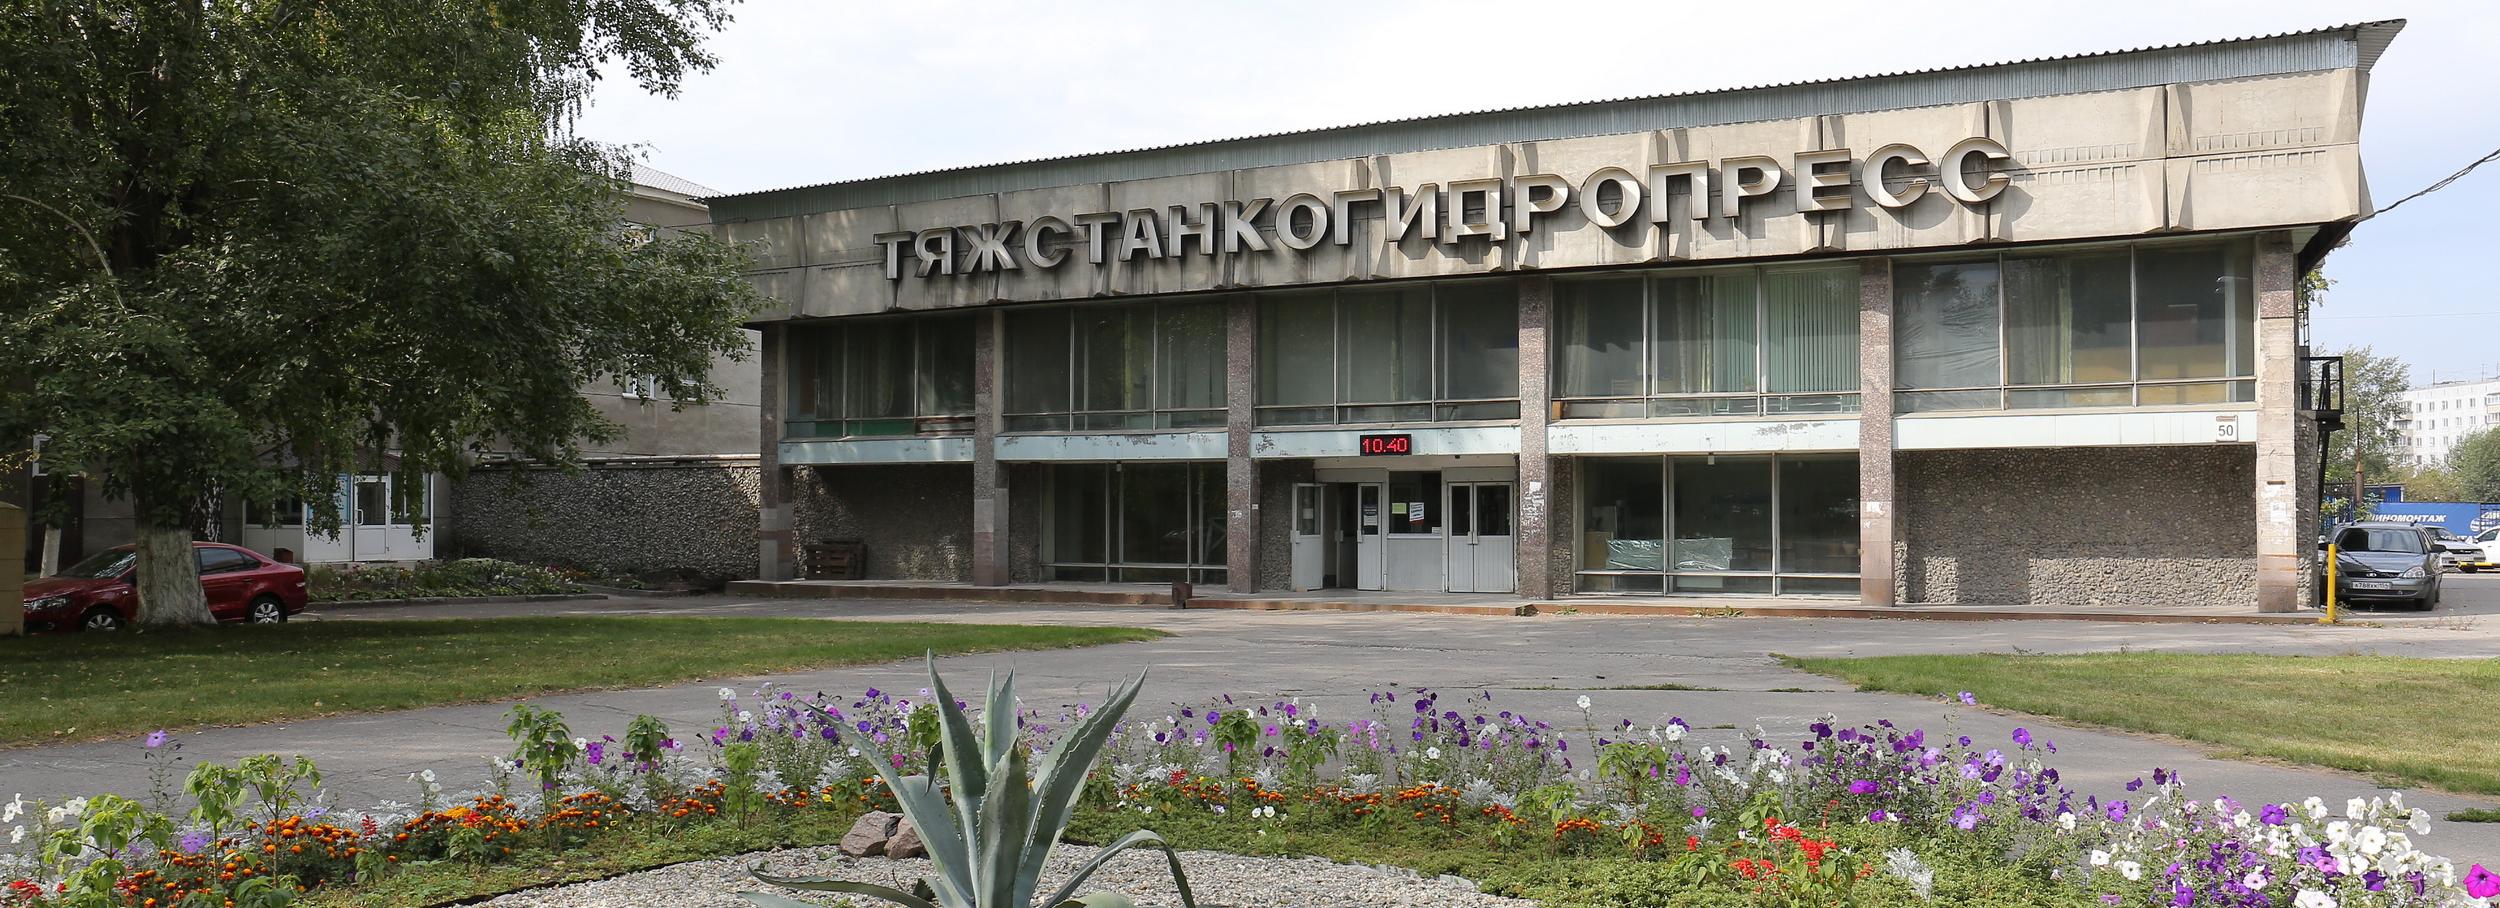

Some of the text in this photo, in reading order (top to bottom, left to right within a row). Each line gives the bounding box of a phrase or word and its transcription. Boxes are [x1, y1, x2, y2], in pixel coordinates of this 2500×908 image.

[873, 136, 2012, 280] ТЯЖСТАНКОГИДРОПРЕСС
[2218, 424, 2234, 437] 50
[1362, 438, 1407, 453] 10.40
